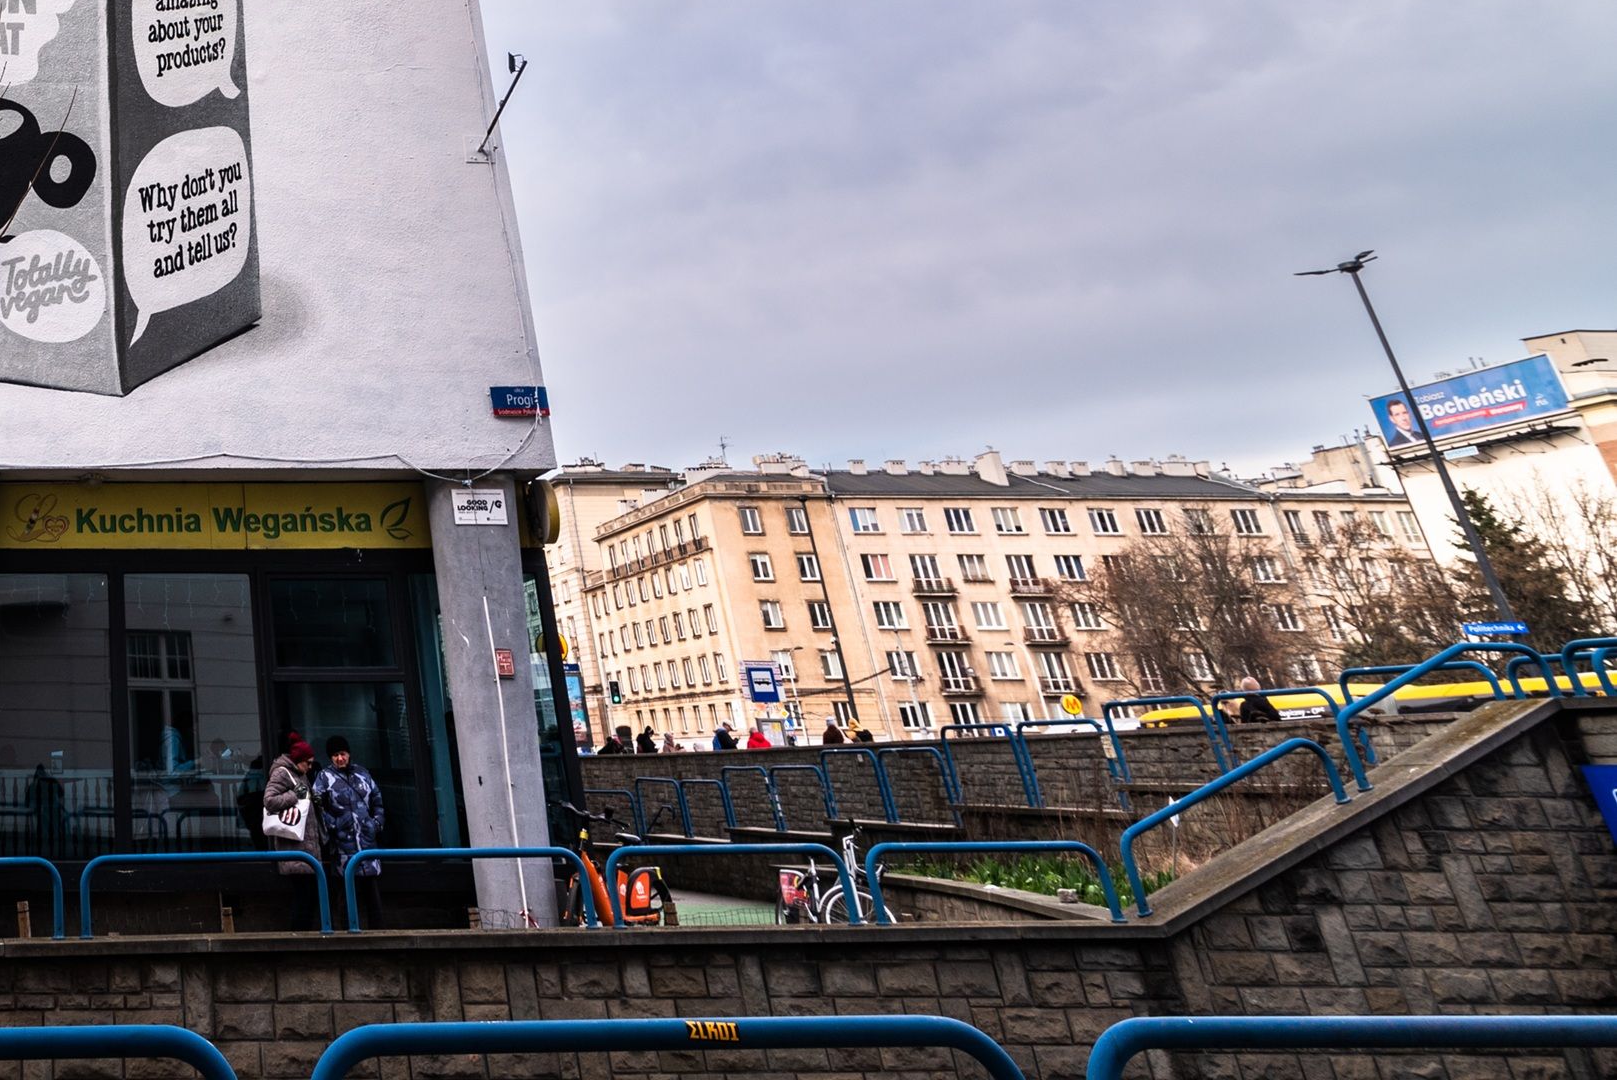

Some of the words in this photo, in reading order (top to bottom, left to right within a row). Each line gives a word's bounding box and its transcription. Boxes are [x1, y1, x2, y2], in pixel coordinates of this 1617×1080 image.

[148, 16, 190, 43] about
[193, 14, 223, 41] your
[156, 37, 226, 77] products?
[138, 182, 178, 213] Why
[182, 168, 215, 200] don't
[218, 162, 242, 193] you
[147, 217, 177, 244] try
[180, 203, 219, 233] them
[221, 189, 238, 217] all
[153, 244, 185, 278] and
[187, 232, 213, 266] tell
[213, 222, 238, 254] us?
[1, 249, 98, 296] Totally
[0, 283, 90, 324] vegan
[506, 393, 534, 408] Progi
[1418, 379, 1527, 420] Bocheński
[76, 507, 202, 534] Kuchnia
[212, 506, 372, 540] Wegańska
